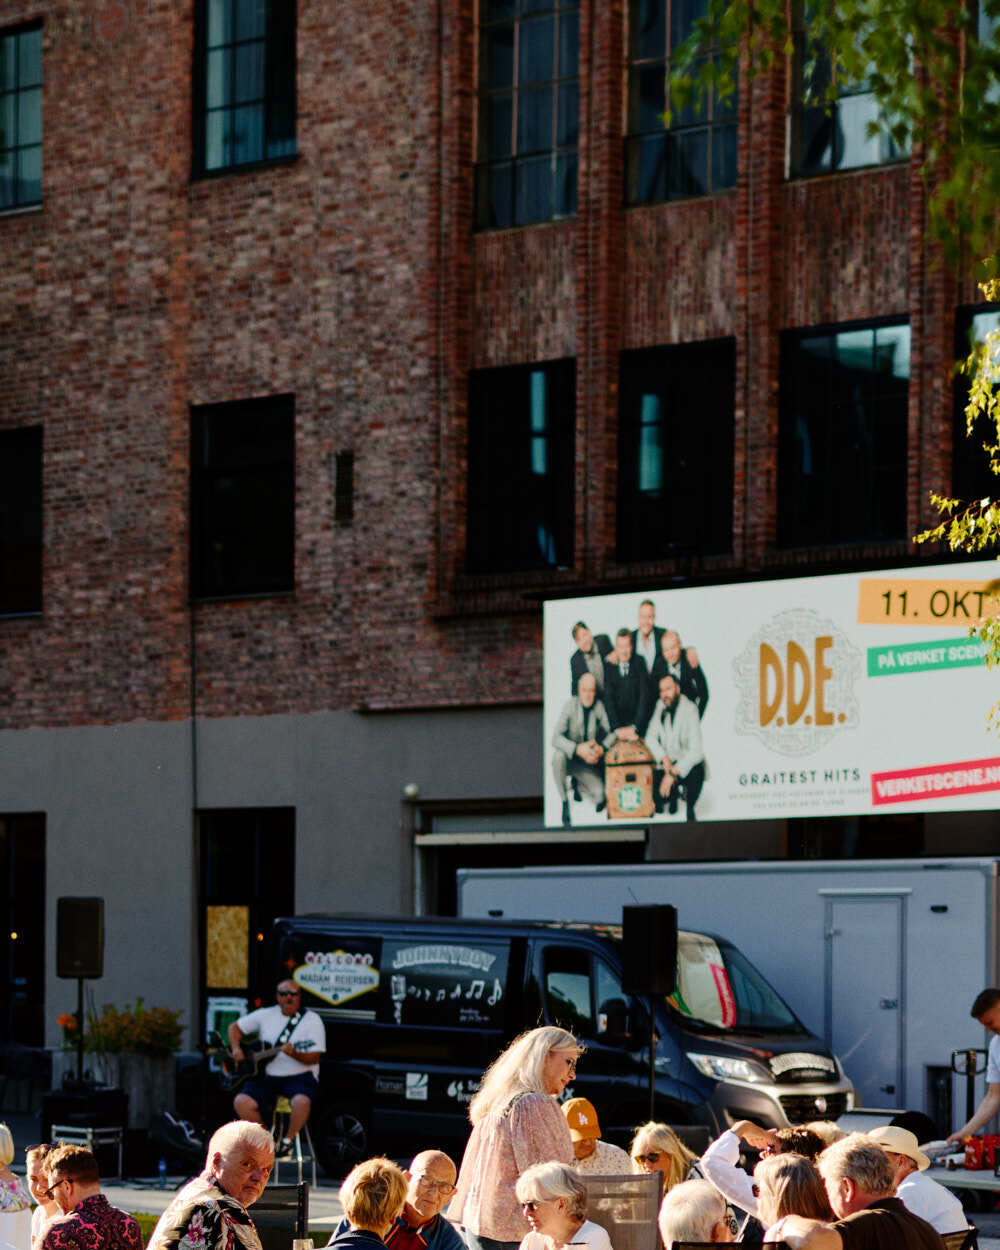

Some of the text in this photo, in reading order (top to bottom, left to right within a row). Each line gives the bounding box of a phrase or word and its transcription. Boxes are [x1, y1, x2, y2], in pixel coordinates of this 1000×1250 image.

[881, 589, 919, 616] 11.
[877, 651, 896, 669] PÅ
[897, 647, 946, 667] VERKET
[759, 635, 848, 728] D.D.E.
[738, 768, 861, 787] GRAITEST HITS
